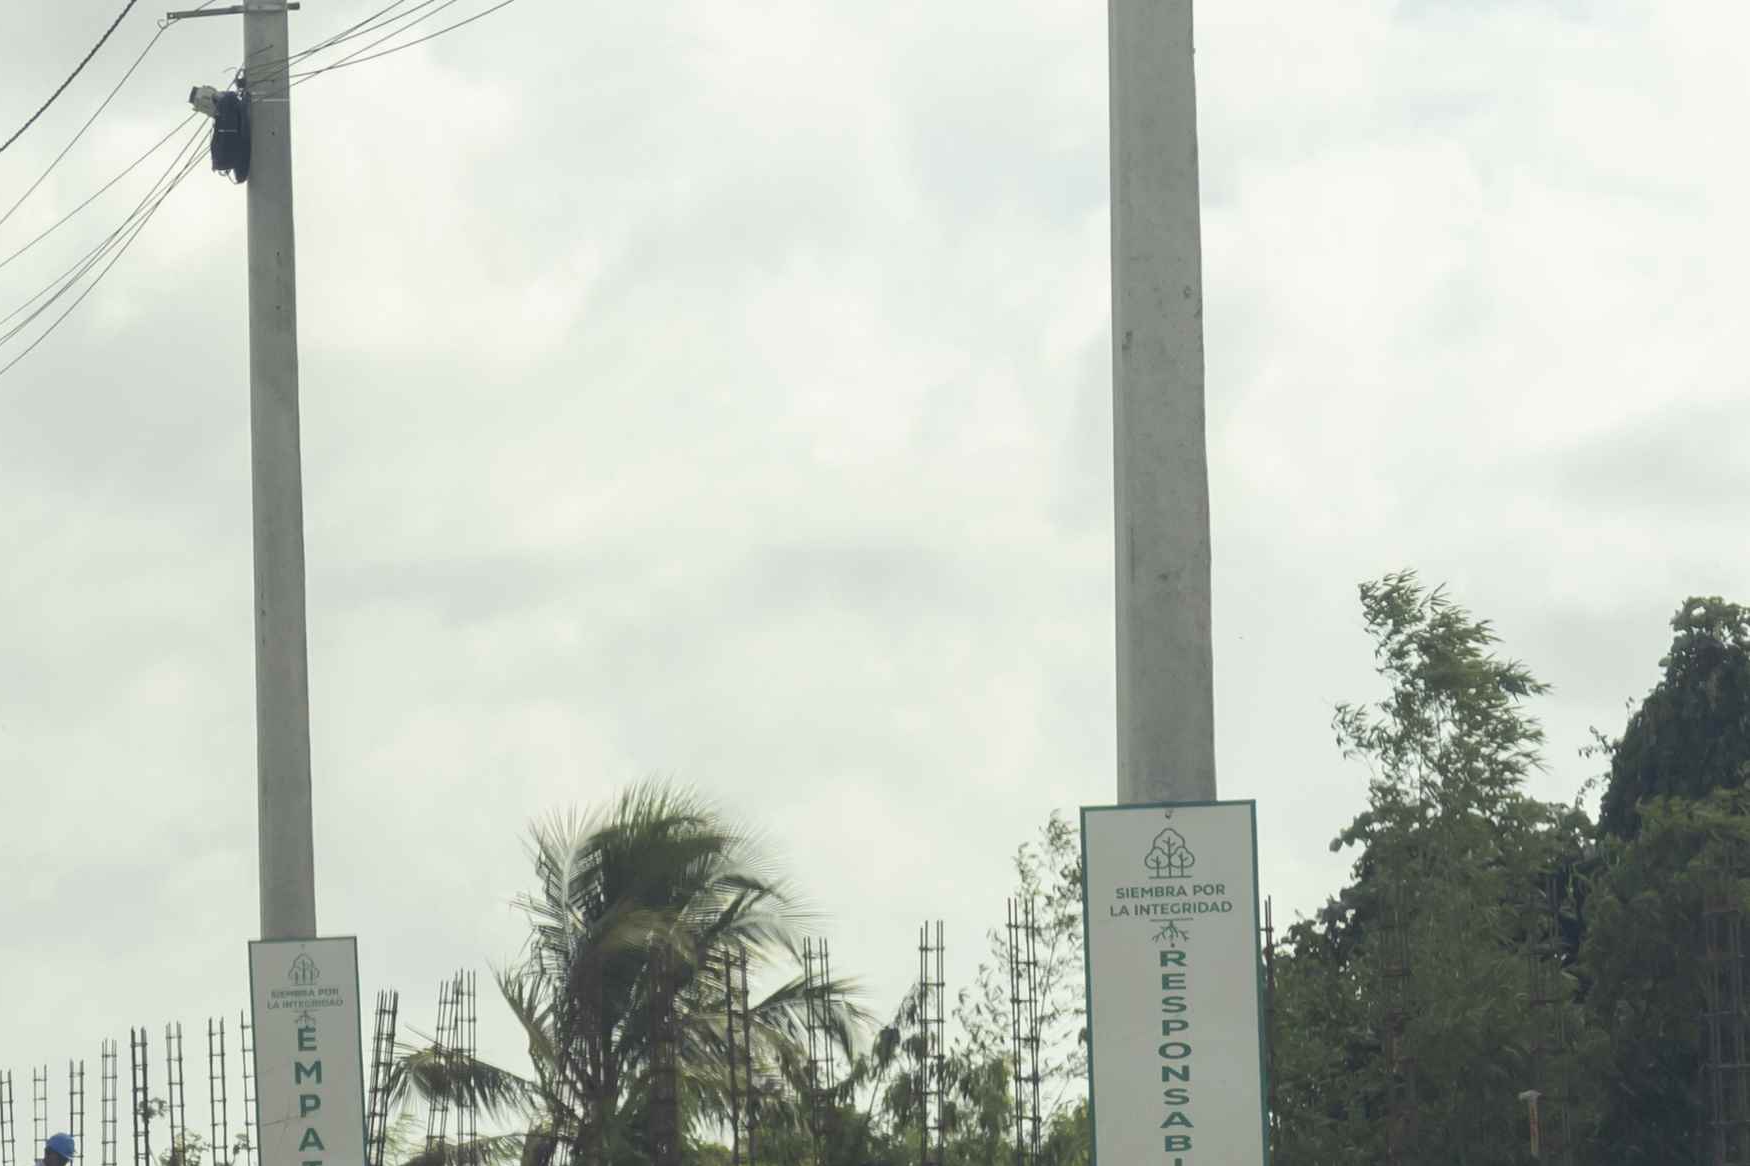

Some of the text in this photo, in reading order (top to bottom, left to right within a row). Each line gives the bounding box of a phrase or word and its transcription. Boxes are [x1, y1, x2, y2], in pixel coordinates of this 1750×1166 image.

[1115, 884, 1226, 900] SIEMBRA POR
[1110, 901, 1233, 917] LA INTEGRIDAD
[267, 1001, 280, 1009] LA
